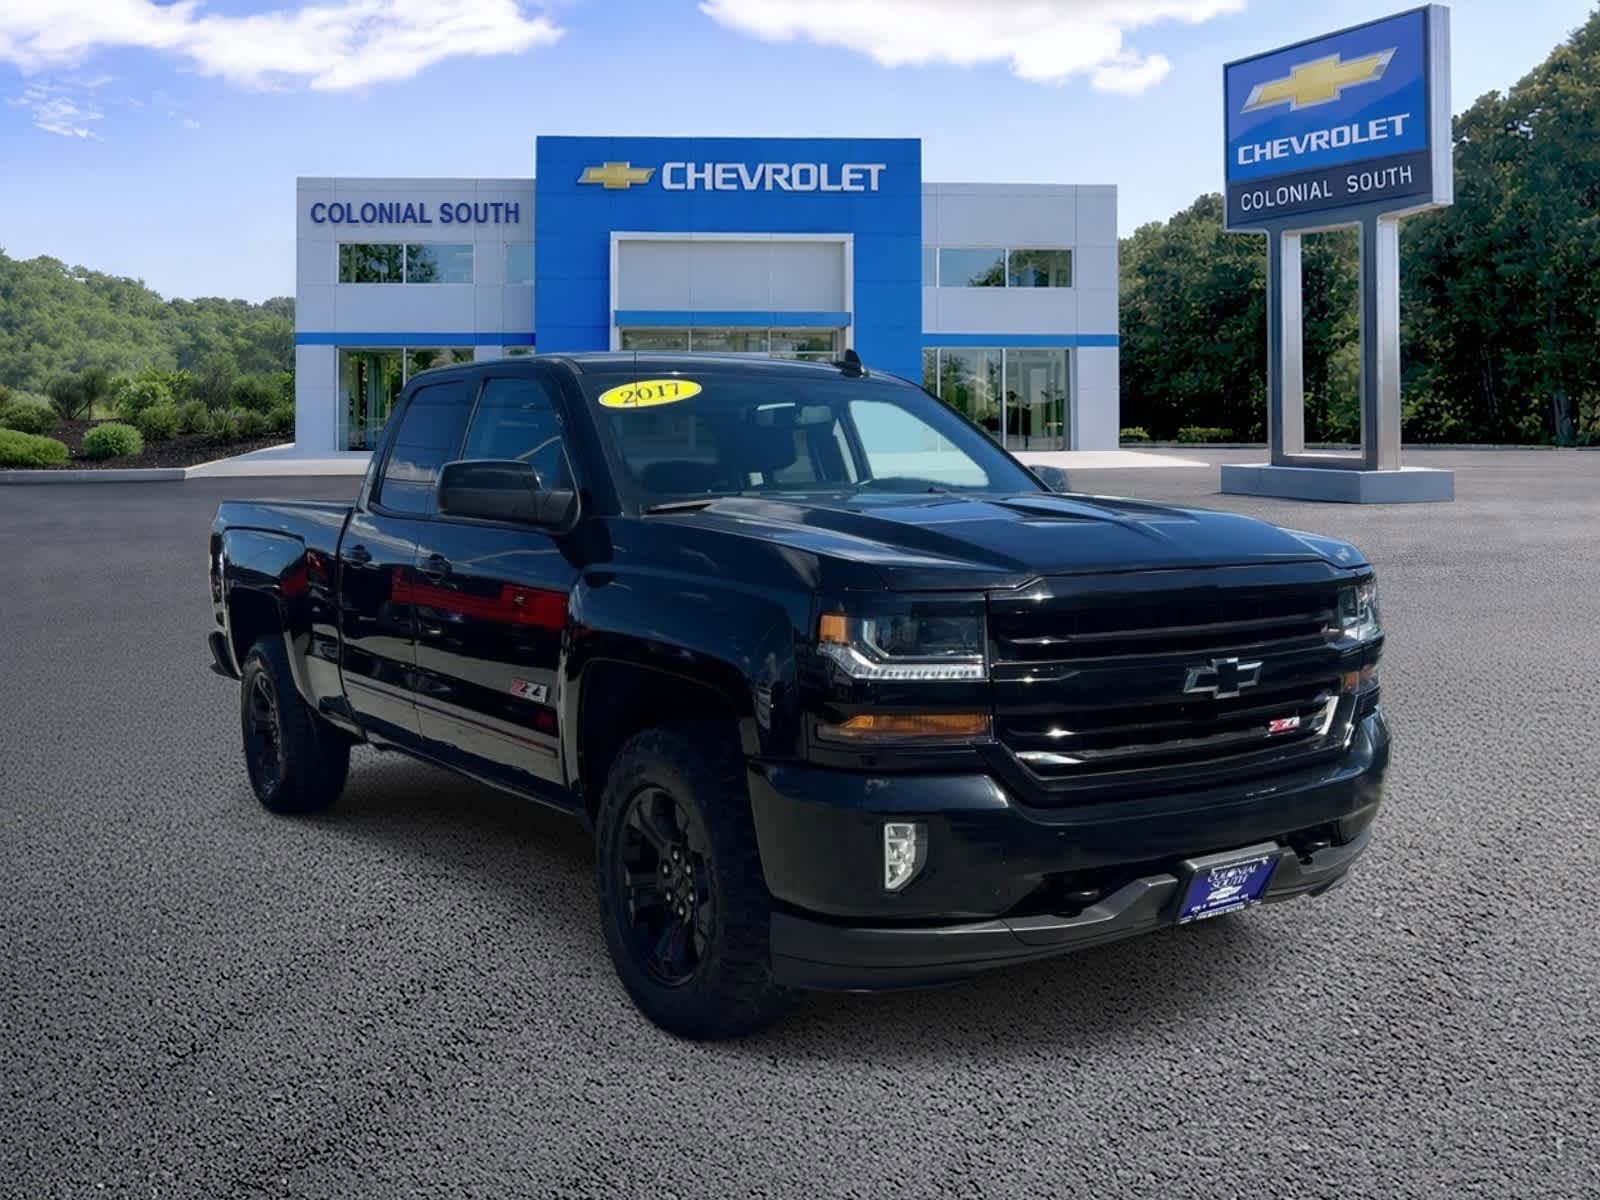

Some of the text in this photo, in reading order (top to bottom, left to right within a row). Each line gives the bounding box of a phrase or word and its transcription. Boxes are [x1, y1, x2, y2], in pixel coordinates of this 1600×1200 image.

[1238, 113, 1410, 165] CHEVROLET
[661, 162, 887, 191] CHEVROLET
[1240, 165, 1413, 211] COLONIAL SOUTH
[310, 202, 520, 224] COLONIAL SOUTH
[619, 383, 679, 403] 2017
[1211, 874, 1249, 891] SOUTH
